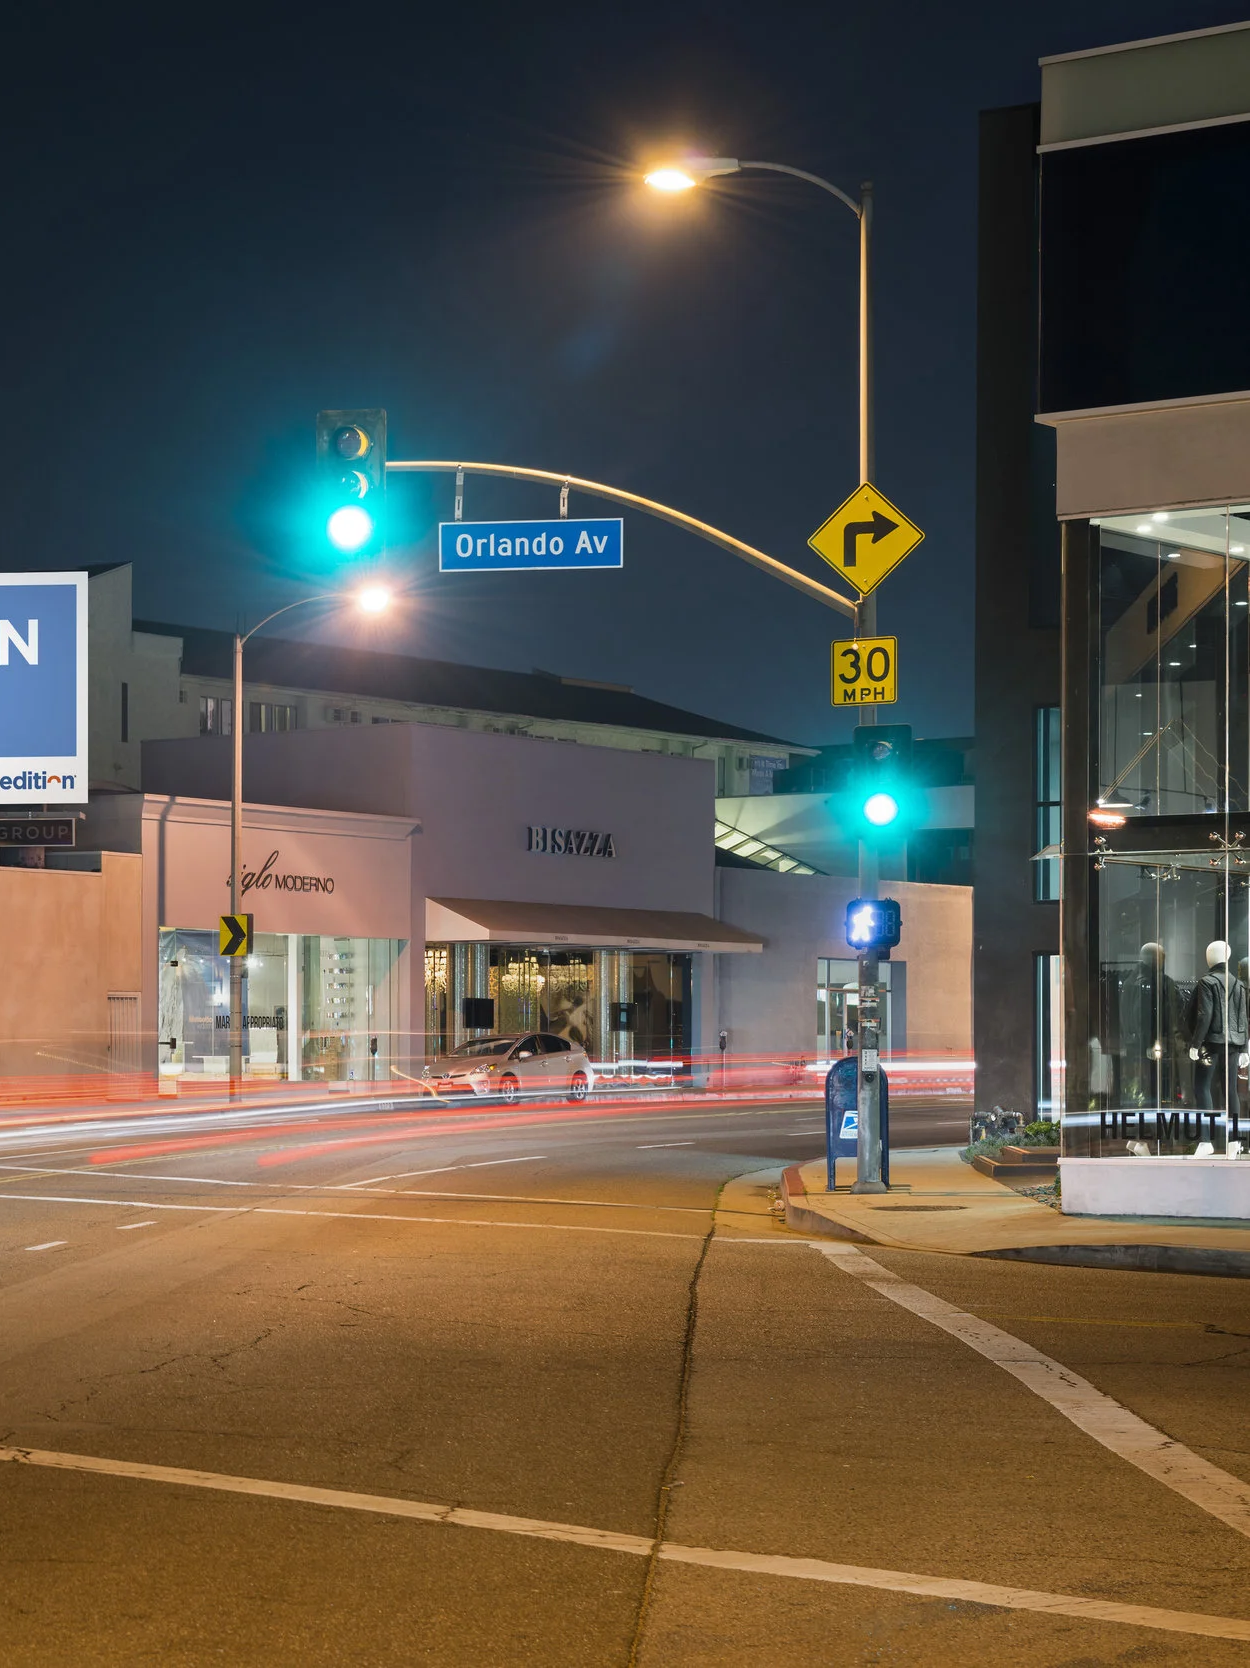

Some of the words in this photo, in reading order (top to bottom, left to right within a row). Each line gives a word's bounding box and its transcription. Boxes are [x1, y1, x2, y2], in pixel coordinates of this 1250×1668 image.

[455, 531, 564, 558] Orlando
[575, 530, 609, 554] Av
[838, 646, 890, 684] 30
[843, 686, 885, 702] MPH
[528, 826, 616, 858] BISAZZA
[275, 873, 335, 895] MODERNO
[1100, 1112, 1222, 1140] HELMUT
